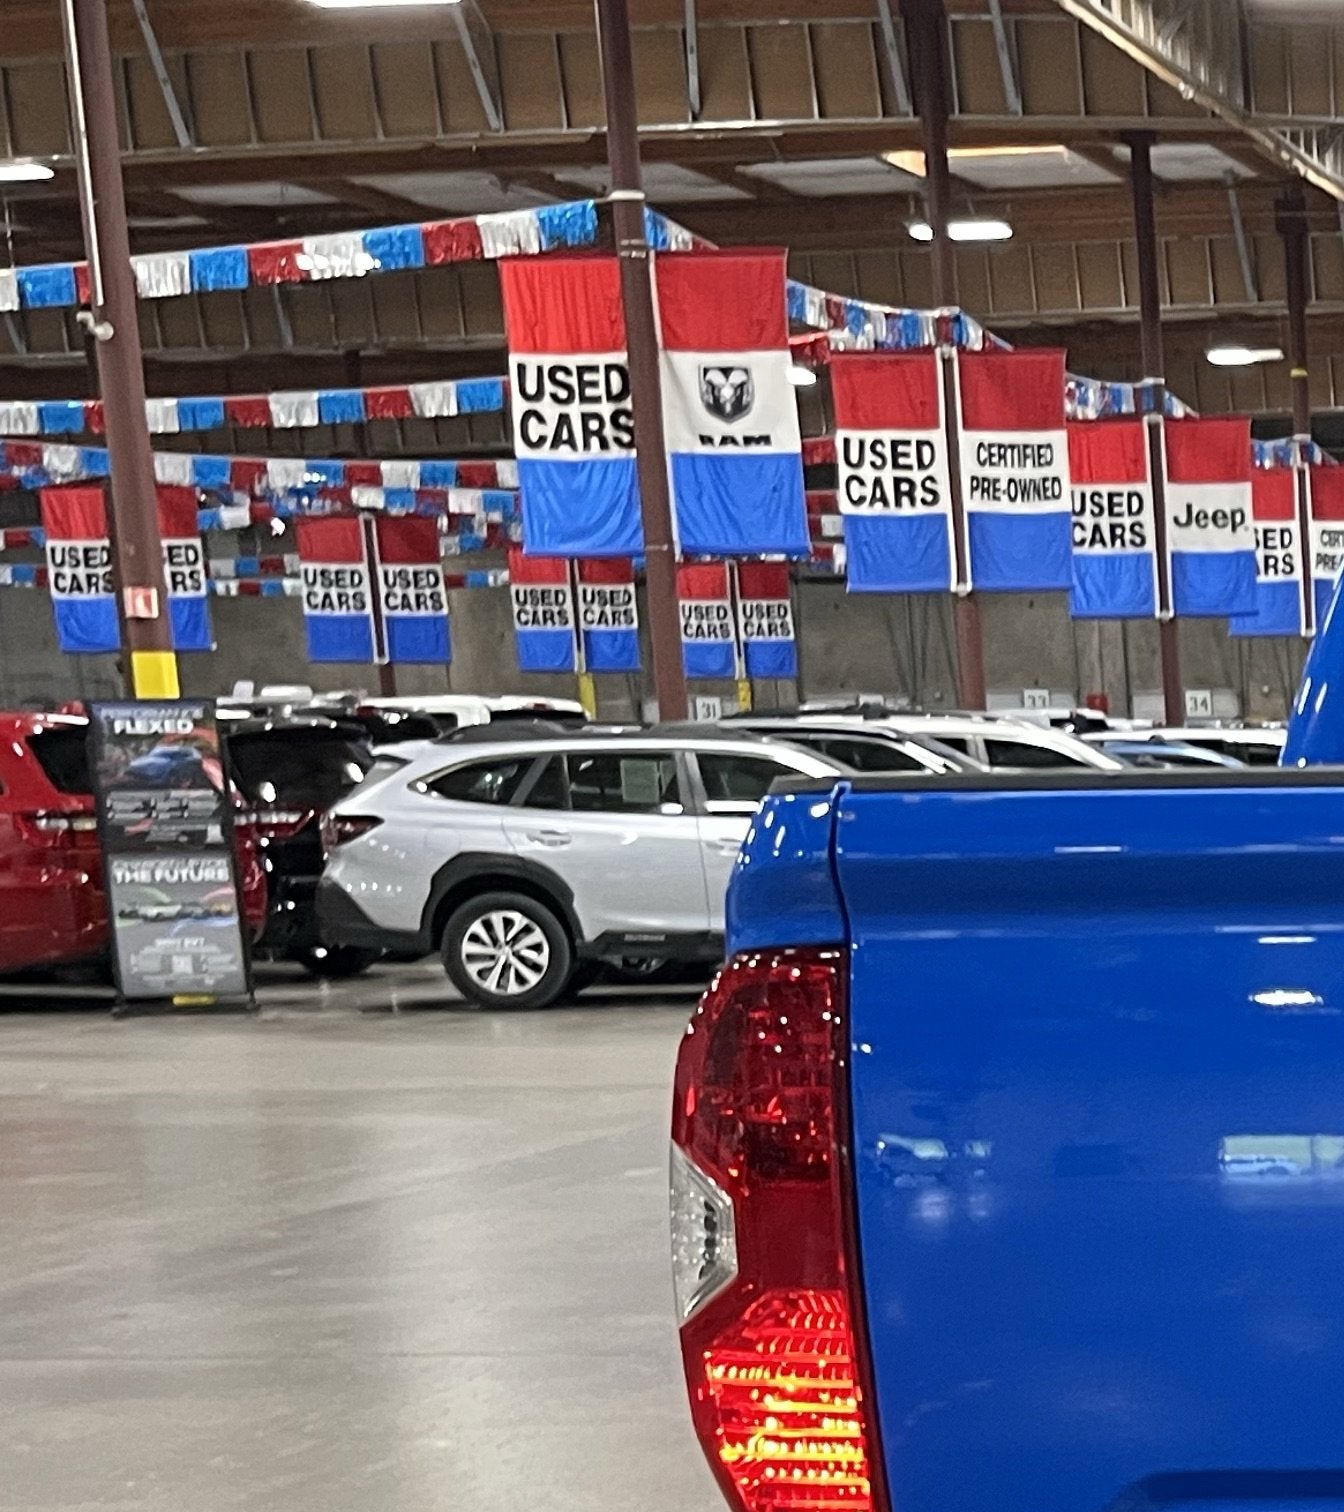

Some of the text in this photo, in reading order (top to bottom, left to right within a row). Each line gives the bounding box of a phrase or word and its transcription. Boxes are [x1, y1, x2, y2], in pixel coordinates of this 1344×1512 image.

[517, 363, 631, 405] USED
[519, 409, 636, 450] CARS
[698, 434, 772, 447] RAM
[843, 437, 936, 471] USED
[976, 442, 1054, 468] CERTIFIED
[845, 475, 941, 508] CARS
[969, 475, 1063, 503] PRE-OWNED
[1071, 489, 1144, 518] USED
[1173, 502, 1246, 533] Jeep
[1072, 520, 1147, 548] CARS
[51, 545, 111, 568] USED
[53, 570, 115, 593] CARS
[304, 568, 363, 589] USED
[383, 568, 440, 590] USED
[306, 591, 367, 611] CARS
[384, 591, 444, 612] CARS
[515, 588, 566, 607] USED
[582, 588, 632, 607] USED
[516, 608, 569, 626] CARS
[583, 608, 634, 626] CARS
[681, 604, 728, 621] USED
[742, 604, 788, 620] USED
[683, 622, 731, 638] CARS
[744, 621, 791, 637] CARS
[701, 702, 716, 718] 31
[1189, 695, 1209, 712] 34
[115, 867, 230, 883] THE FUTURE
